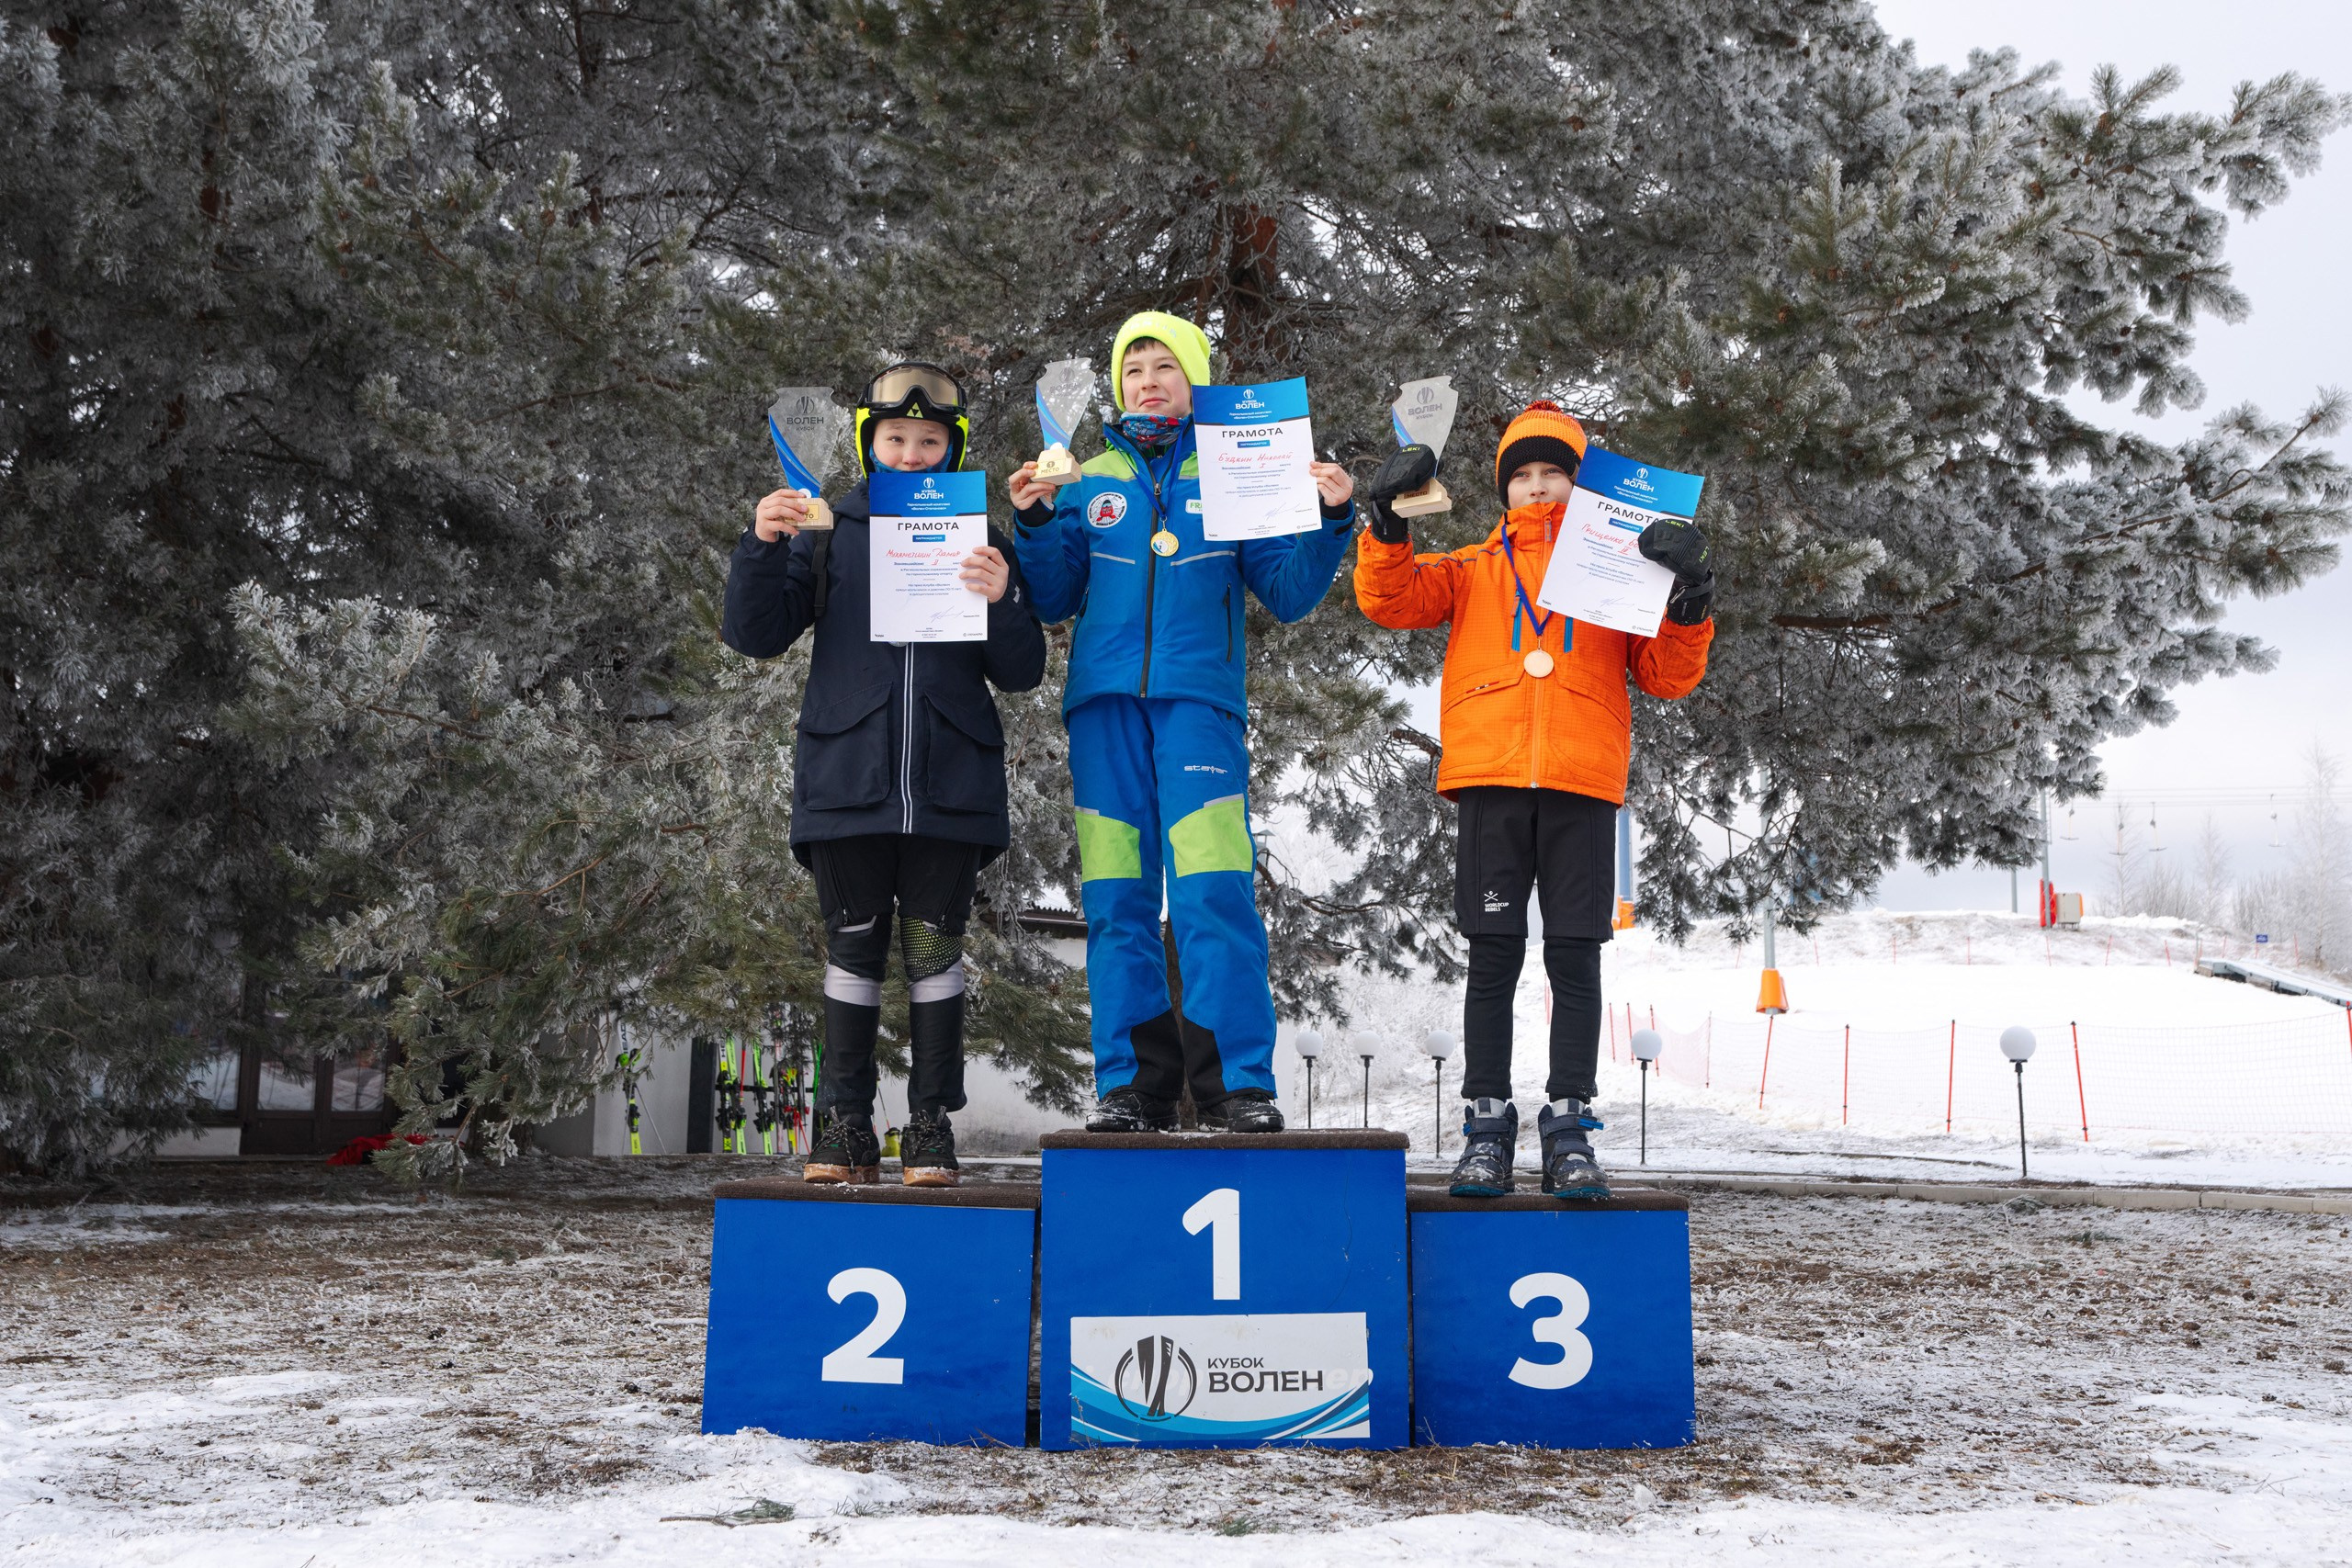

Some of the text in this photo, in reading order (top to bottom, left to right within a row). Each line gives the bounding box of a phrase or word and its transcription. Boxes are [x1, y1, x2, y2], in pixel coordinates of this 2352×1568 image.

[1235, 401, 1265, 410] ВОЛЕН
[1408, 402, 1442, 416] ВОЛЕН
[786, 416, 824, 425] ВОЛЕН
[1222, 427, 1283, 438] ГРАМОТА
[1623, 478, 1655, 492] ВОЛЕН
[898, 522, 959, 531] ГРАМОТА
[1665, 520, 1685, 528] LEKI
[1699, 546, 1710, 564] LEKI
[1183, 764, 1228, 774] stayer
[1182, 1188, 1240, 1301] 1
[821, 1268, 907, 1384] 2
[1508, 1272, 1593, 1390] 3
[1207, 1357, 1264, 1369] КУБОК
[1209, 1370, 1324, 1393] ВОЛЕН
